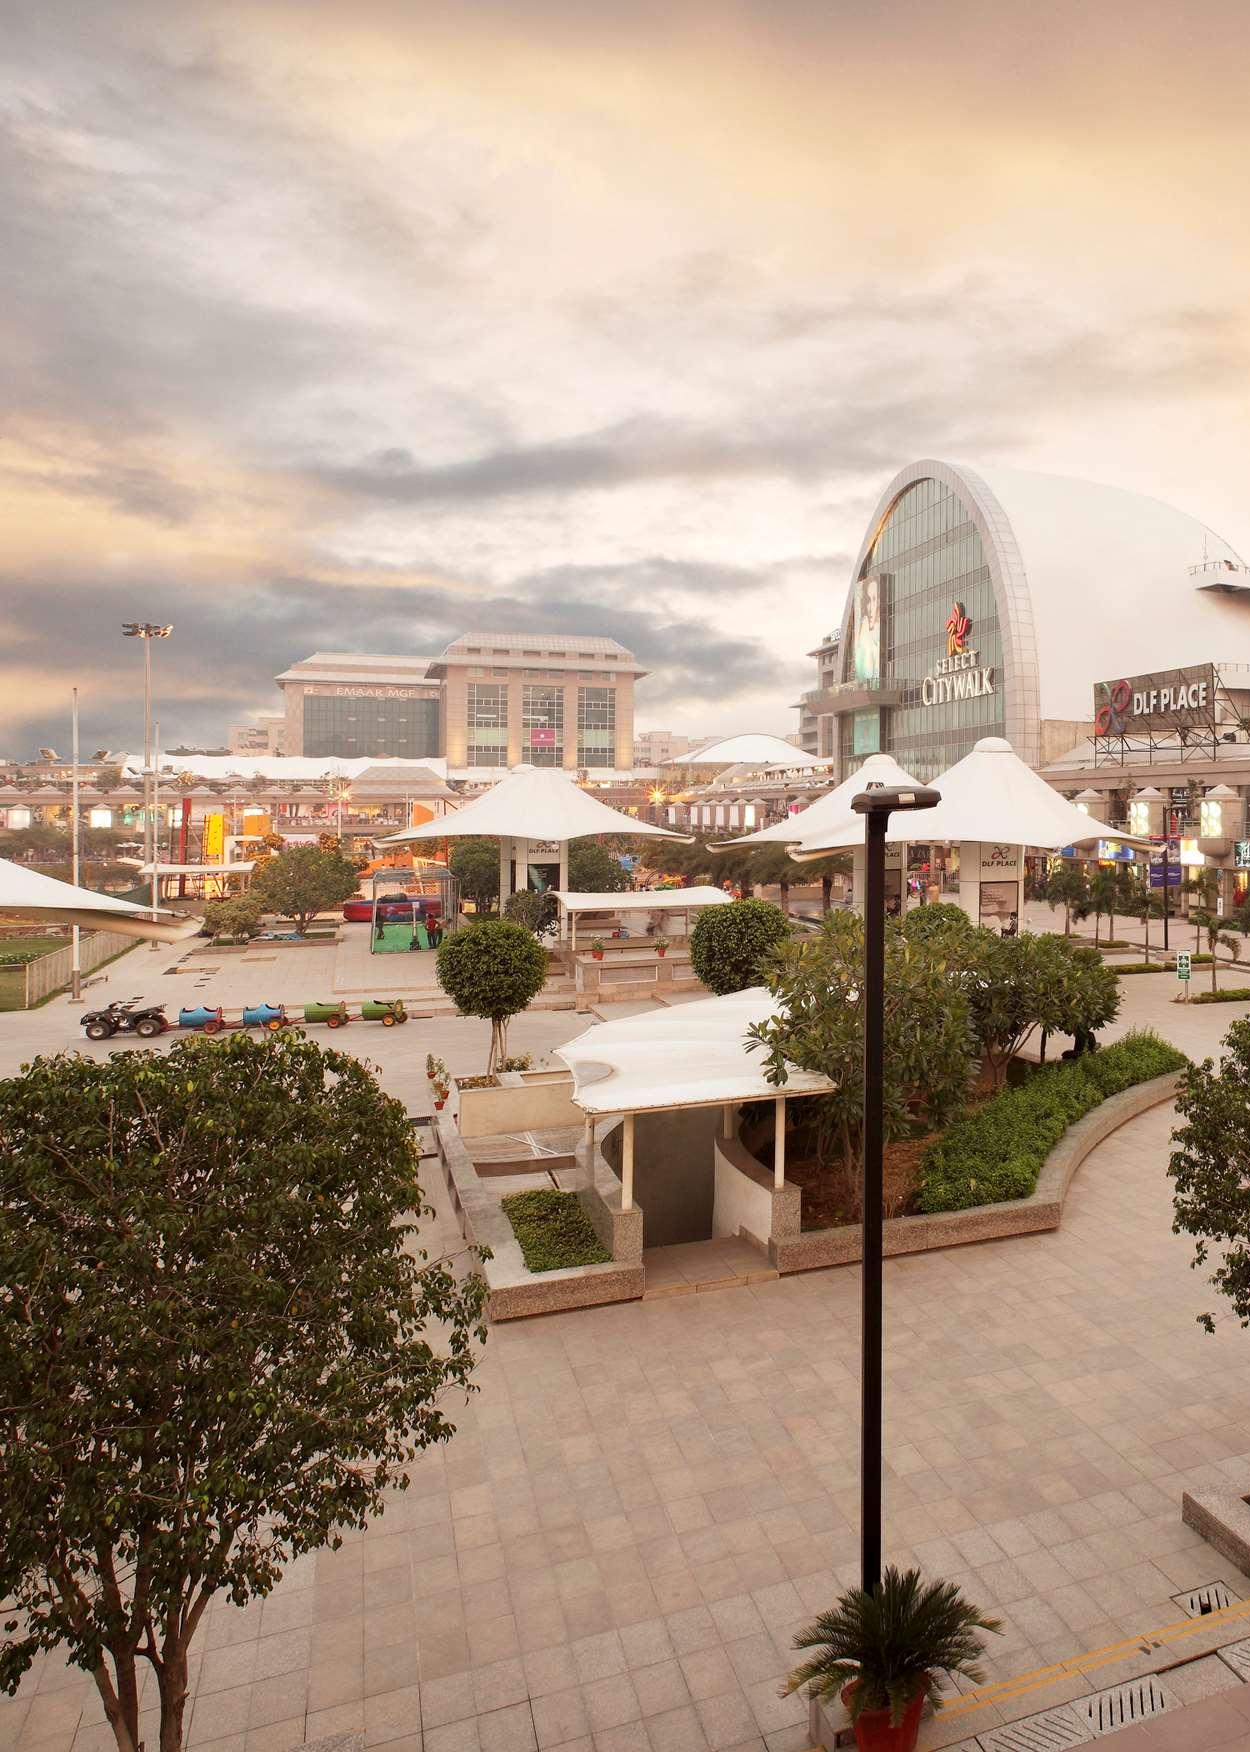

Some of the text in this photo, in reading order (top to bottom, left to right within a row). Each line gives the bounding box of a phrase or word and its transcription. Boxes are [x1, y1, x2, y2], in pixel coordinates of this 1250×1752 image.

[936, 650, 979, 676] SELECT
[336, 687, 416, 697] EMAAR MGF
[922, 667, 994, 706] CITYWALK
[1133, 682, 1207, 716] DLF PLACE
